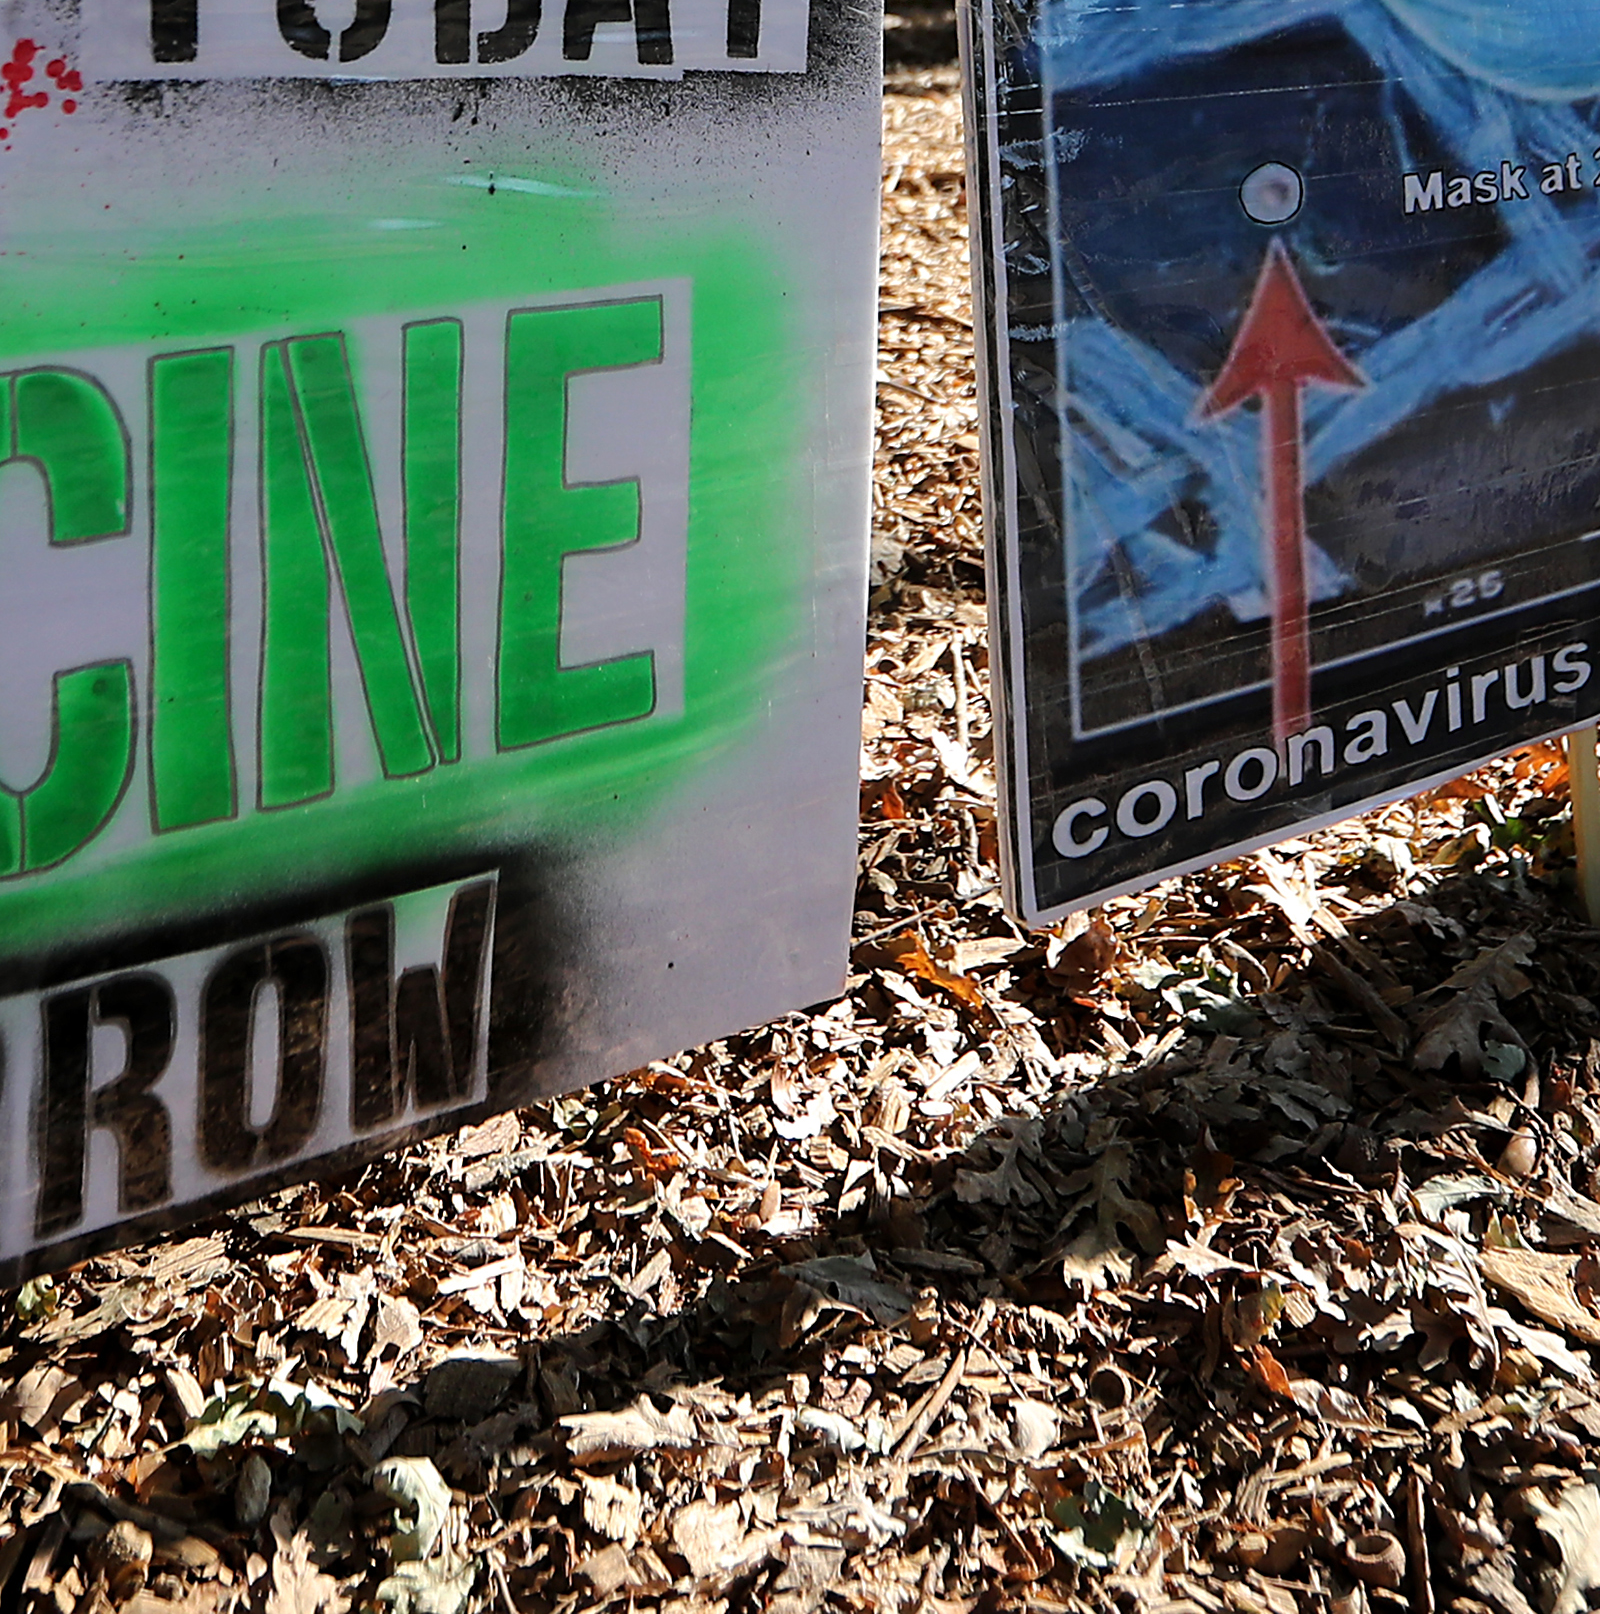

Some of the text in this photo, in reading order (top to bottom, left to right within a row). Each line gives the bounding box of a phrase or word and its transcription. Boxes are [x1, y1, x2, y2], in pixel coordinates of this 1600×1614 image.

[1403, 160, 1530, 215] Mask
[1540, 154, 1584, 194] at
[1050, 641, 1592, 858] coronavirus
